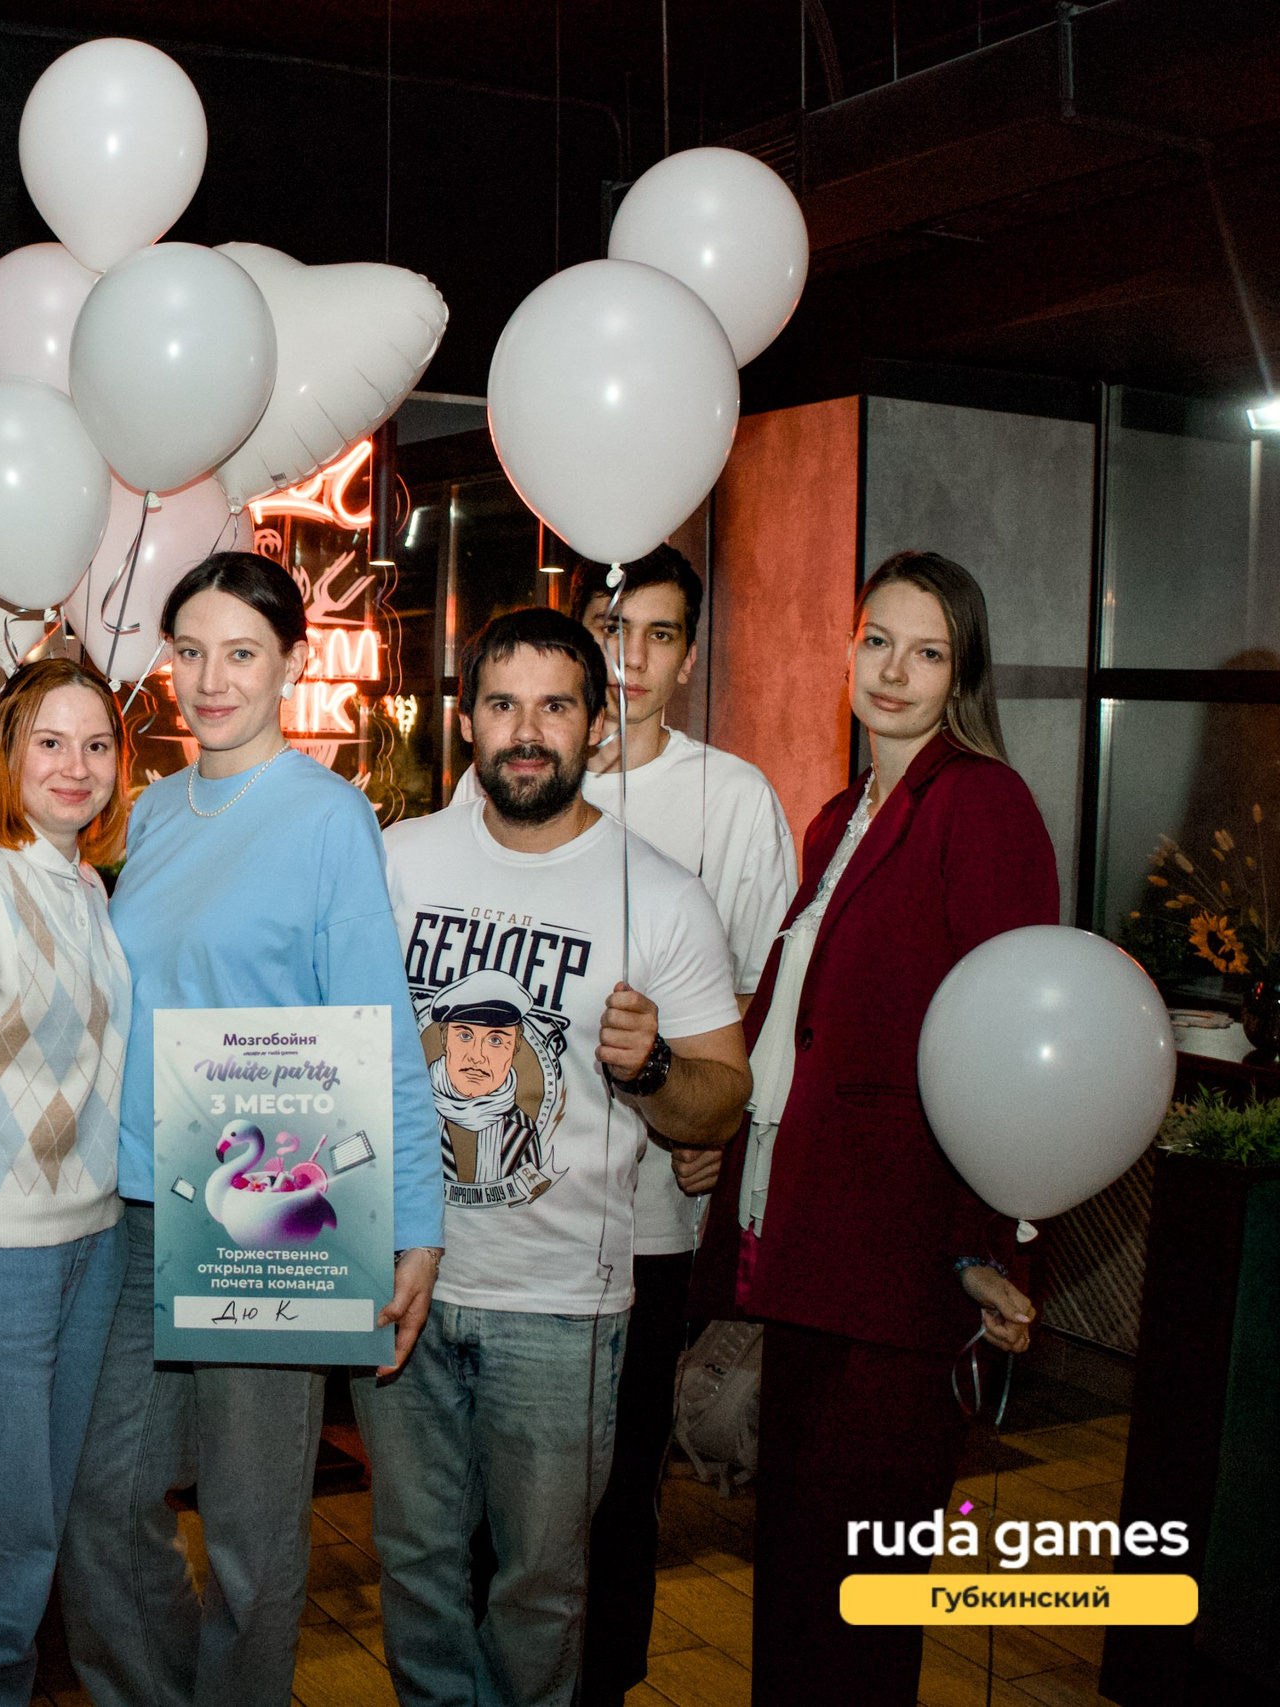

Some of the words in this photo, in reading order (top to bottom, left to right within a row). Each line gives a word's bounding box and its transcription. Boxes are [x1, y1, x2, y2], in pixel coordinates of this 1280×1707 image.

[470, 906, 533, 927] ОСТАП
[405, 911, 592, 1012] БЕНДЕР
[223, 1032, 317, 1046] Мозгобойня
[193, 1054, 272, 1082] White
[272, 1060, 341, 1091] party
[210, 1094, 226, 1115] 3
[234, 1093, 335, 1115] МЕСТО
[449, 1185, 484, 1205] ПАРАДОМ
[484, 1184, 507, 1203] БУДУ
[216, 1247, 329, 1262] Торжественно
[197, 1263, 263, 1276] открыла
[267, 1265, 348, 1276] пьедестал
[211, 1277, 264, 1289] почета
[267, 1278, 335, 1291] команда
